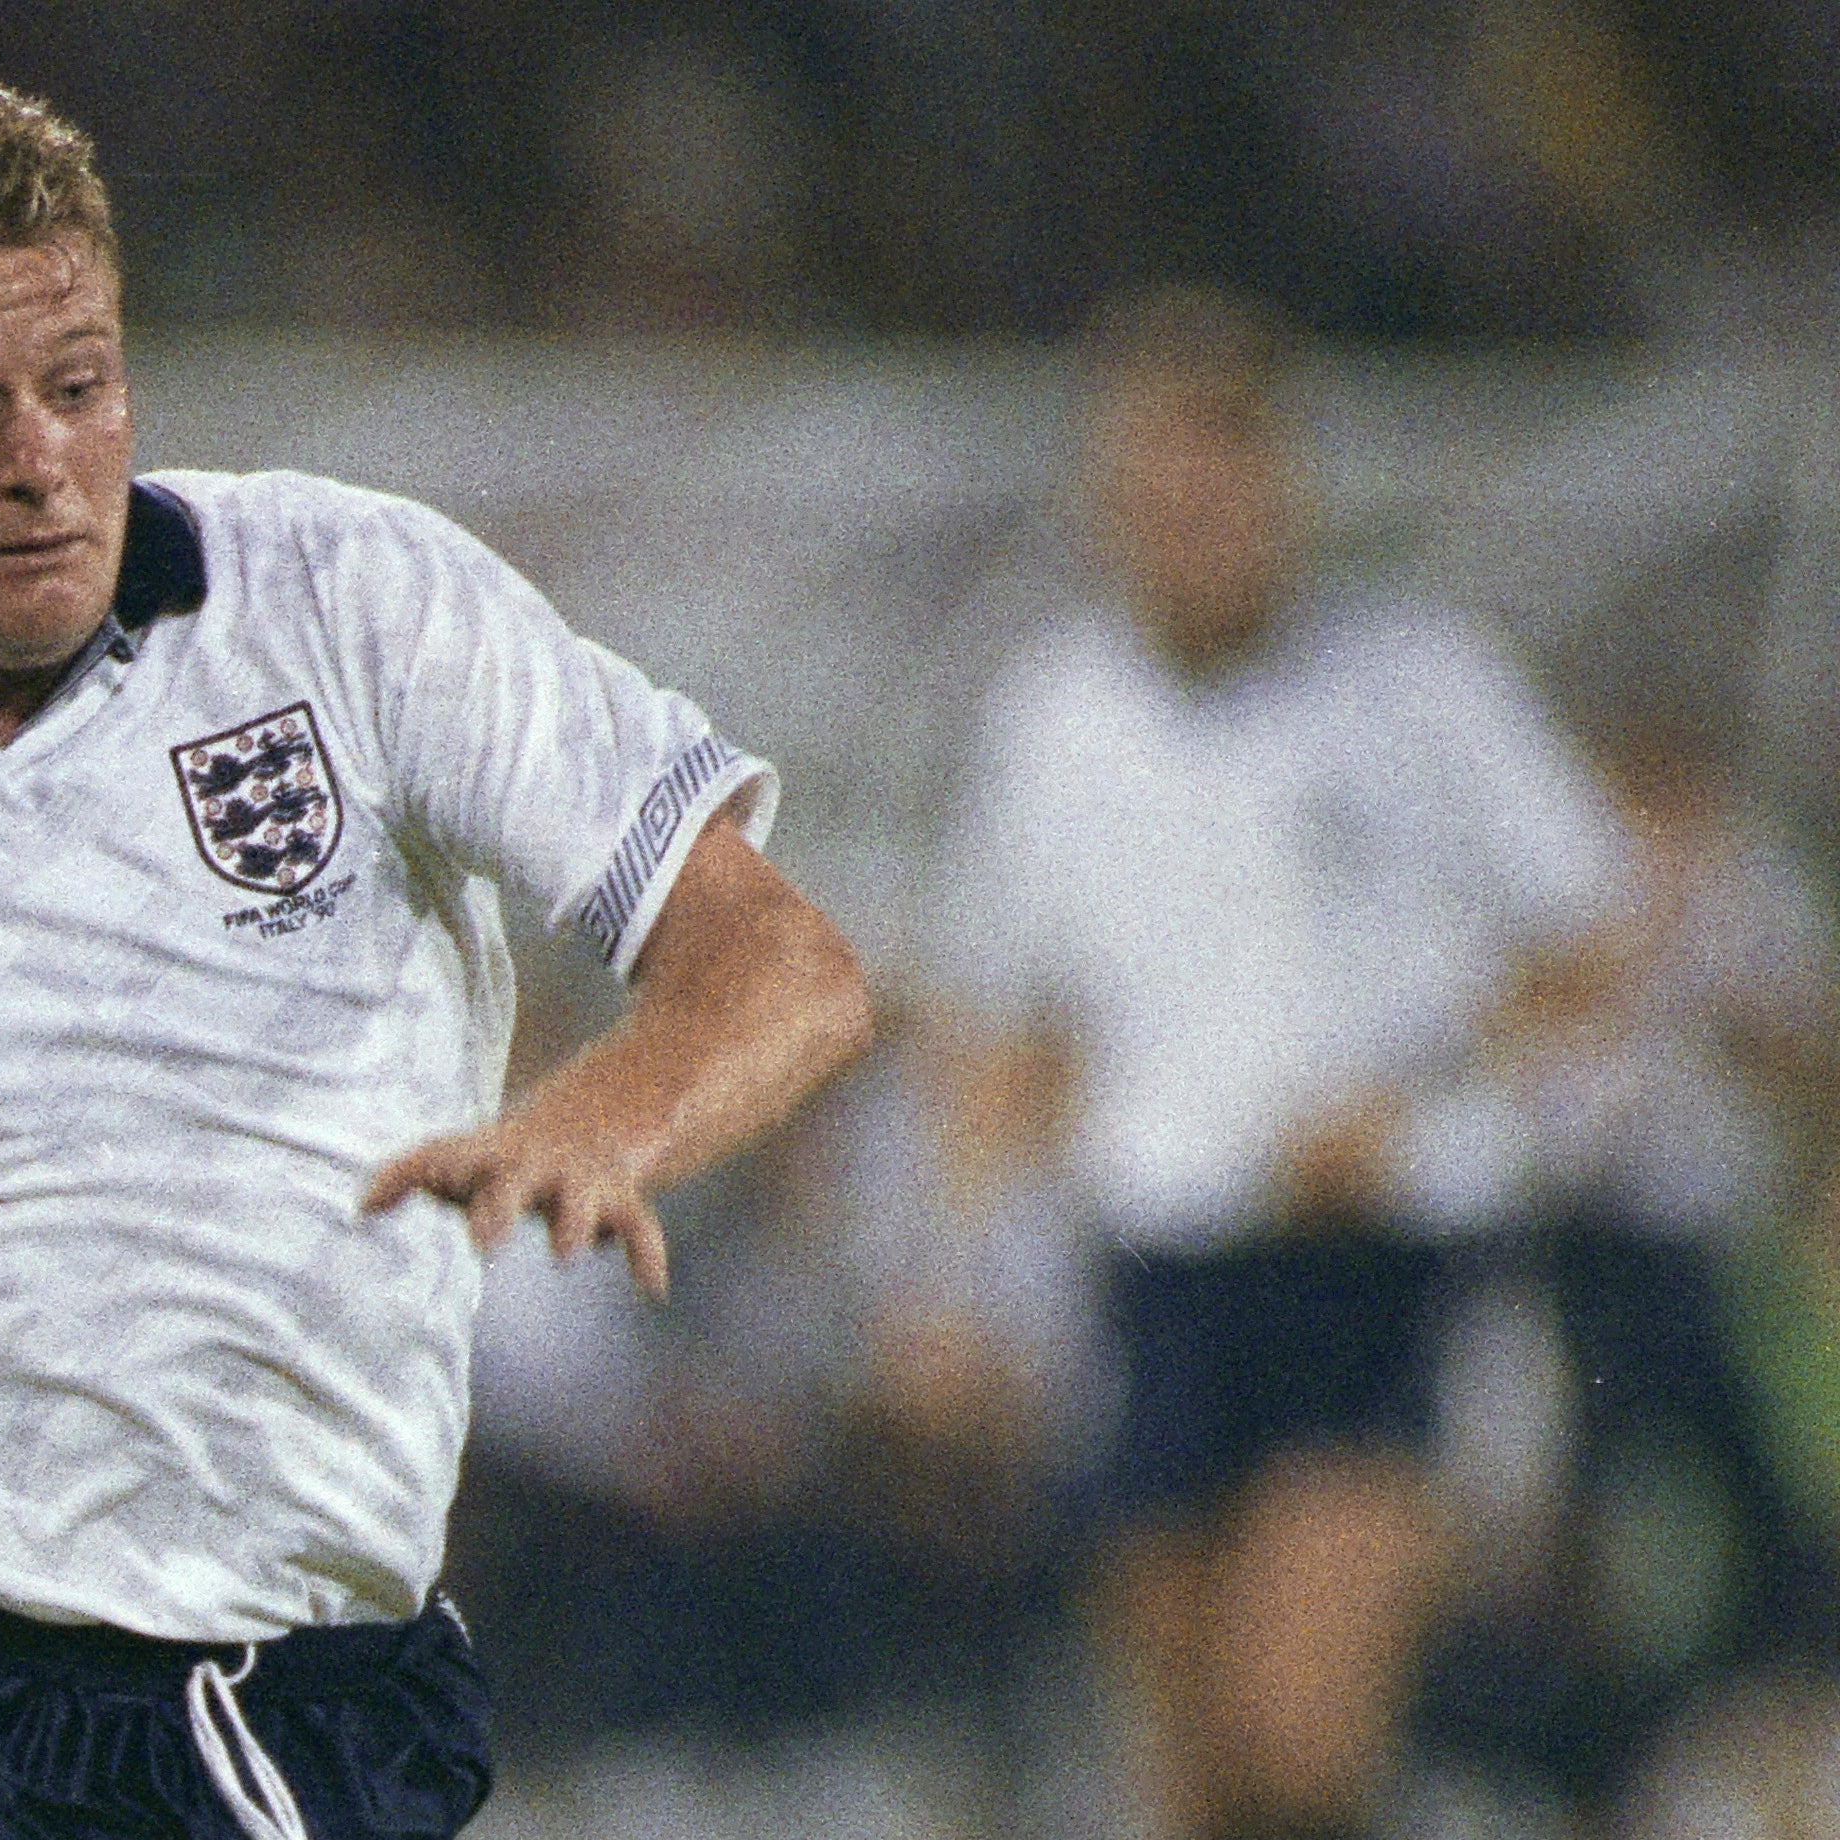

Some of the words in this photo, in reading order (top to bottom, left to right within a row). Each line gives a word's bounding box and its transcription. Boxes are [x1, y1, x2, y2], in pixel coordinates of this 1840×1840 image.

[223, 907, 263, 931] FIFA
[265, 887, 327, 917] WORLD
[259, 911, 308, 940] ITALY
